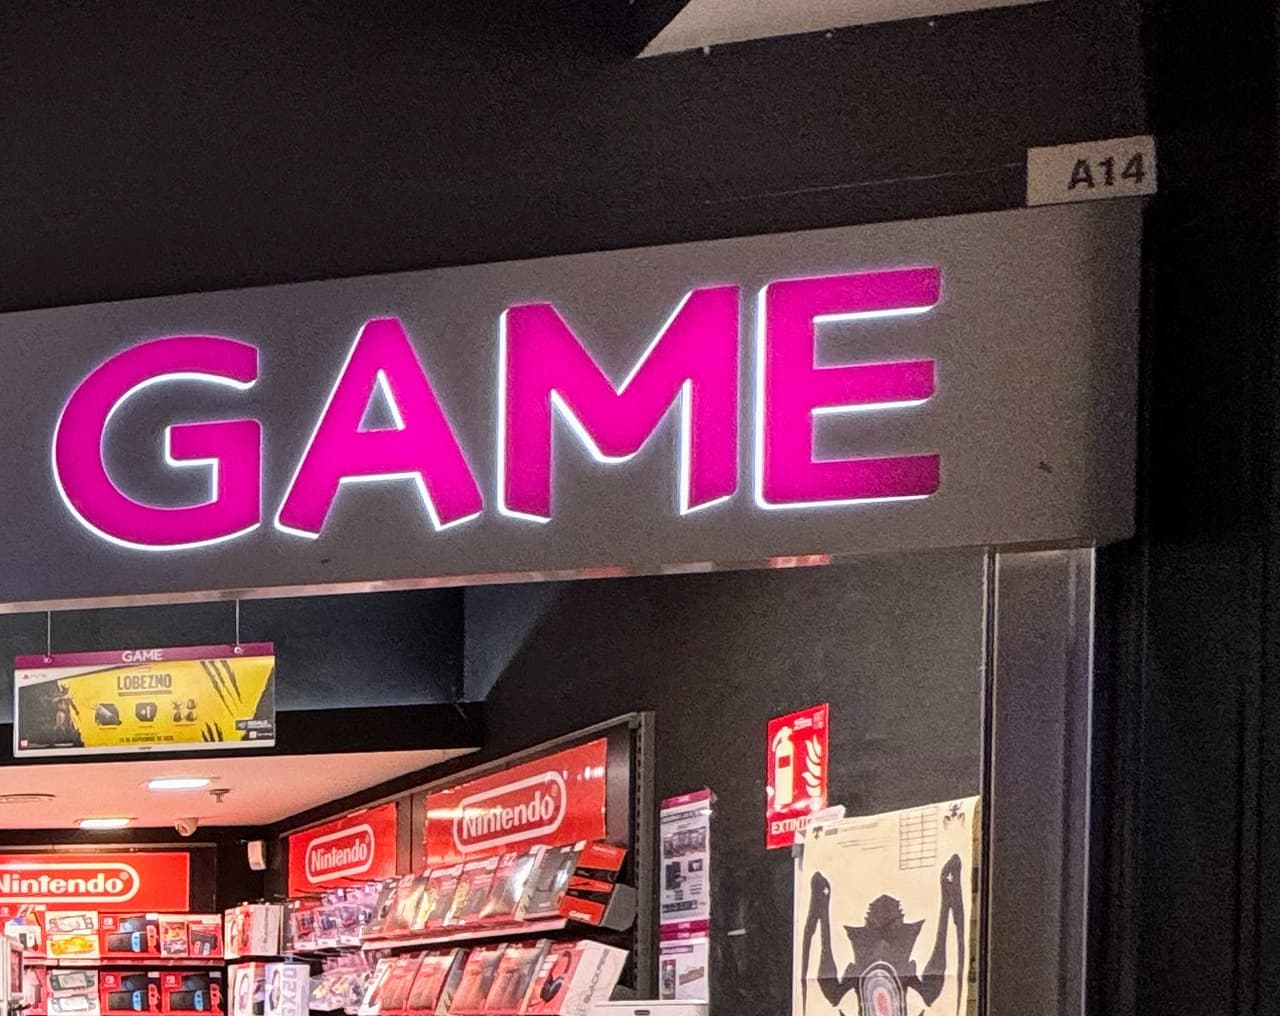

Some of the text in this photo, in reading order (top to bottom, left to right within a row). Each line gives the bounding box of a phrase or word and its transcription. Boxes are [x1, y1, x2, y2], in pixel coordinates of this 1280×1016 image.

[1067, 151, 1145, 190] A14
[51, 264, 943, 553] GAME
[121, 649, 163, 663] GAME
[117, 673, 173, 691] LOBEZNO
[461, 790, 557, 841] Nintendo
[308, 834, 371, 870] Nintendo
